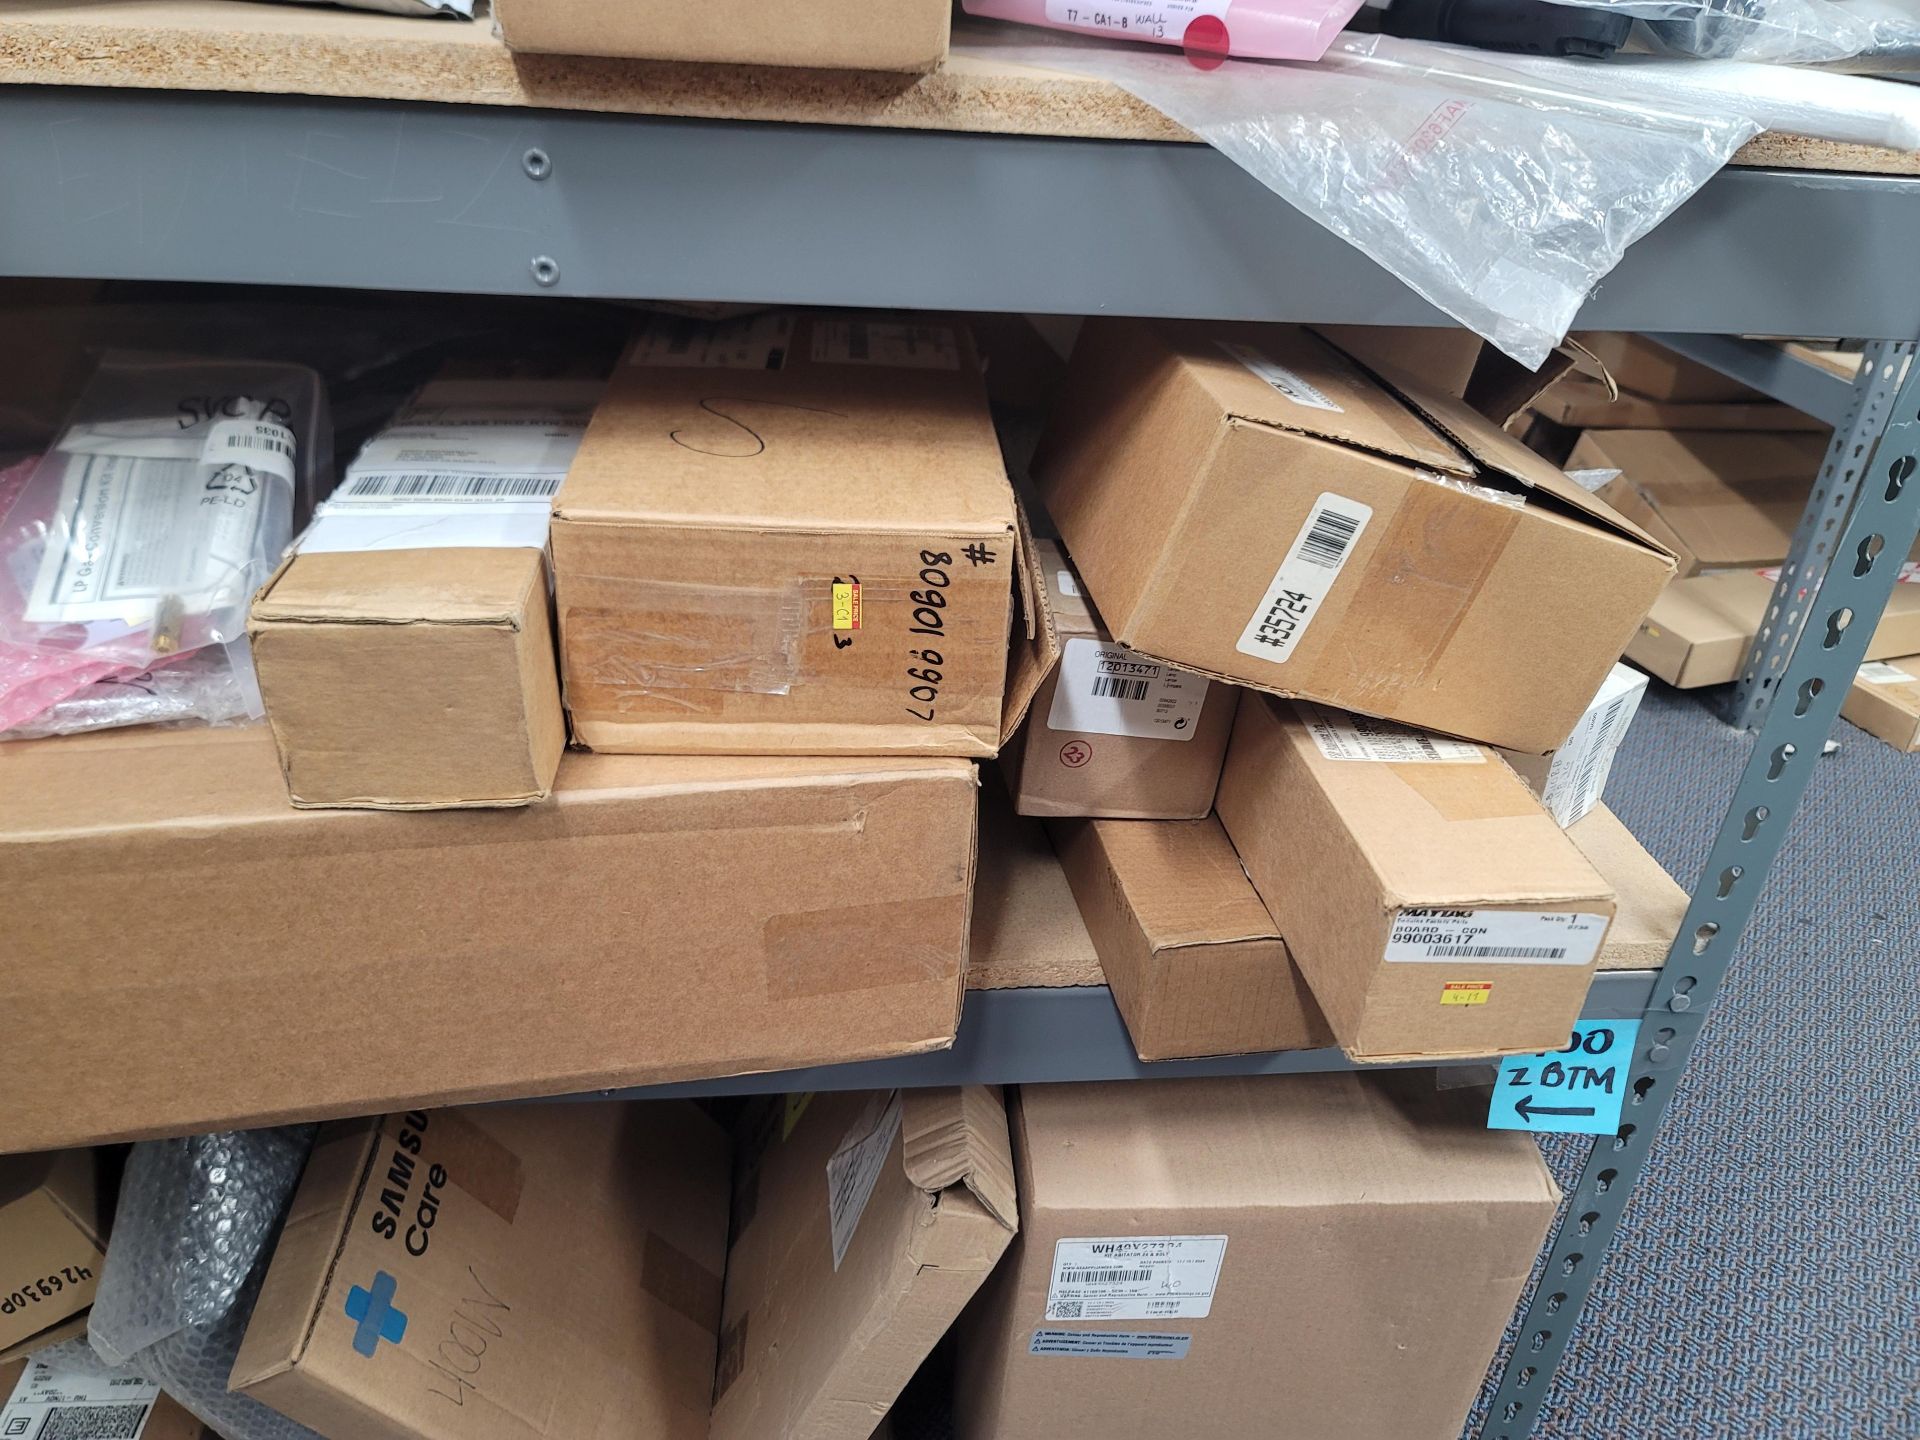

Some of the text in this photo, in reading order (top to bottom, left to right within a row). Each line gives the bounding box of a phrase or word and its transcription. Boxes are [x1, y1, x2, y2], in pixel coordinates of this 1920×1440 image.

[1067, 9, 1078, 22] T7
[1253, 588, 1312, 648] #35724
[1094, 650, 1128, 661] ORIGINAL
[1098, 660, 1160, 677] 12013471
[1391, 934, 1475, 944] 99003617
[1540, 1060, 1616, 1094] BTM
[404, 1162, 449, 1257] Care
[0, 1264, 95, 1315] 426930P
